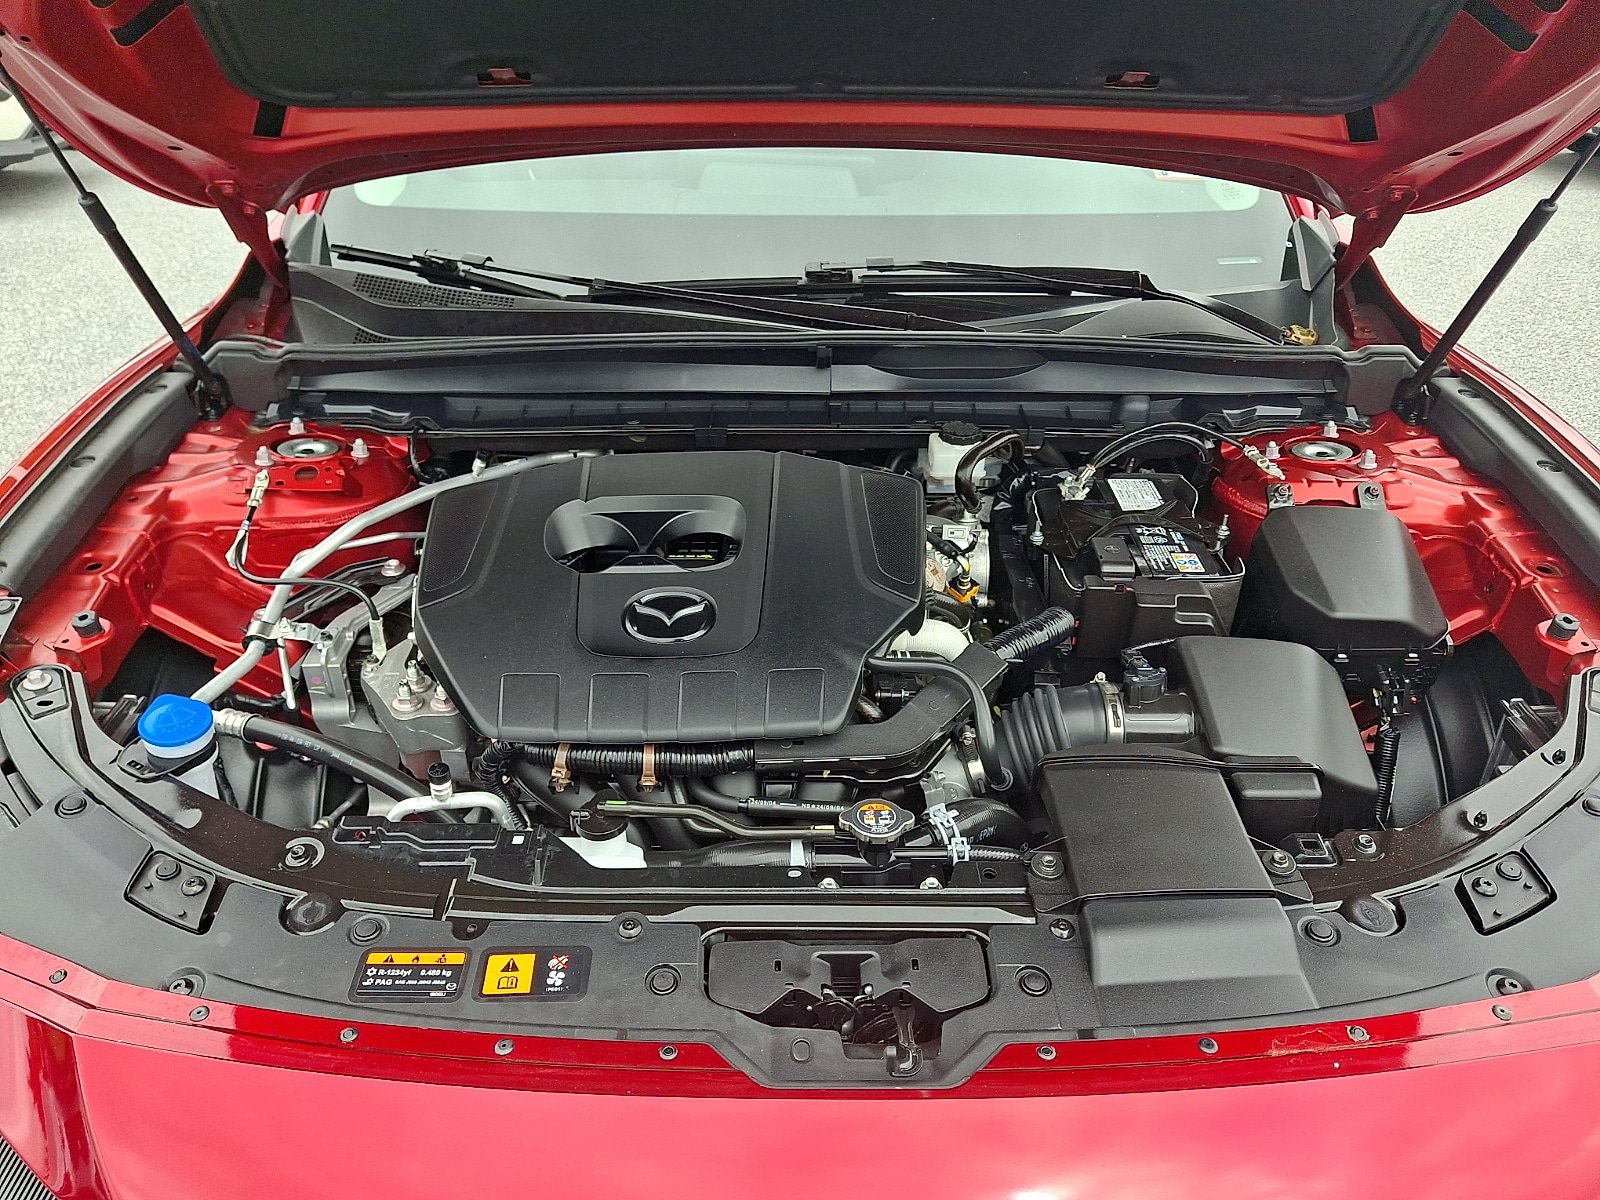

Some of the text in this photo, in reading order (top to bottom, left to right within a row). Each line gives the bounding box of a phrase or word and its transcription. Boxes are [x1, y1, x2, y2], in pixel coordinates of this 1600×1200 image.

[377, 968, 412, 977] R-1234yf
[442, 969, 453, 977] kg
[374, 978, 393, 986] PAG
